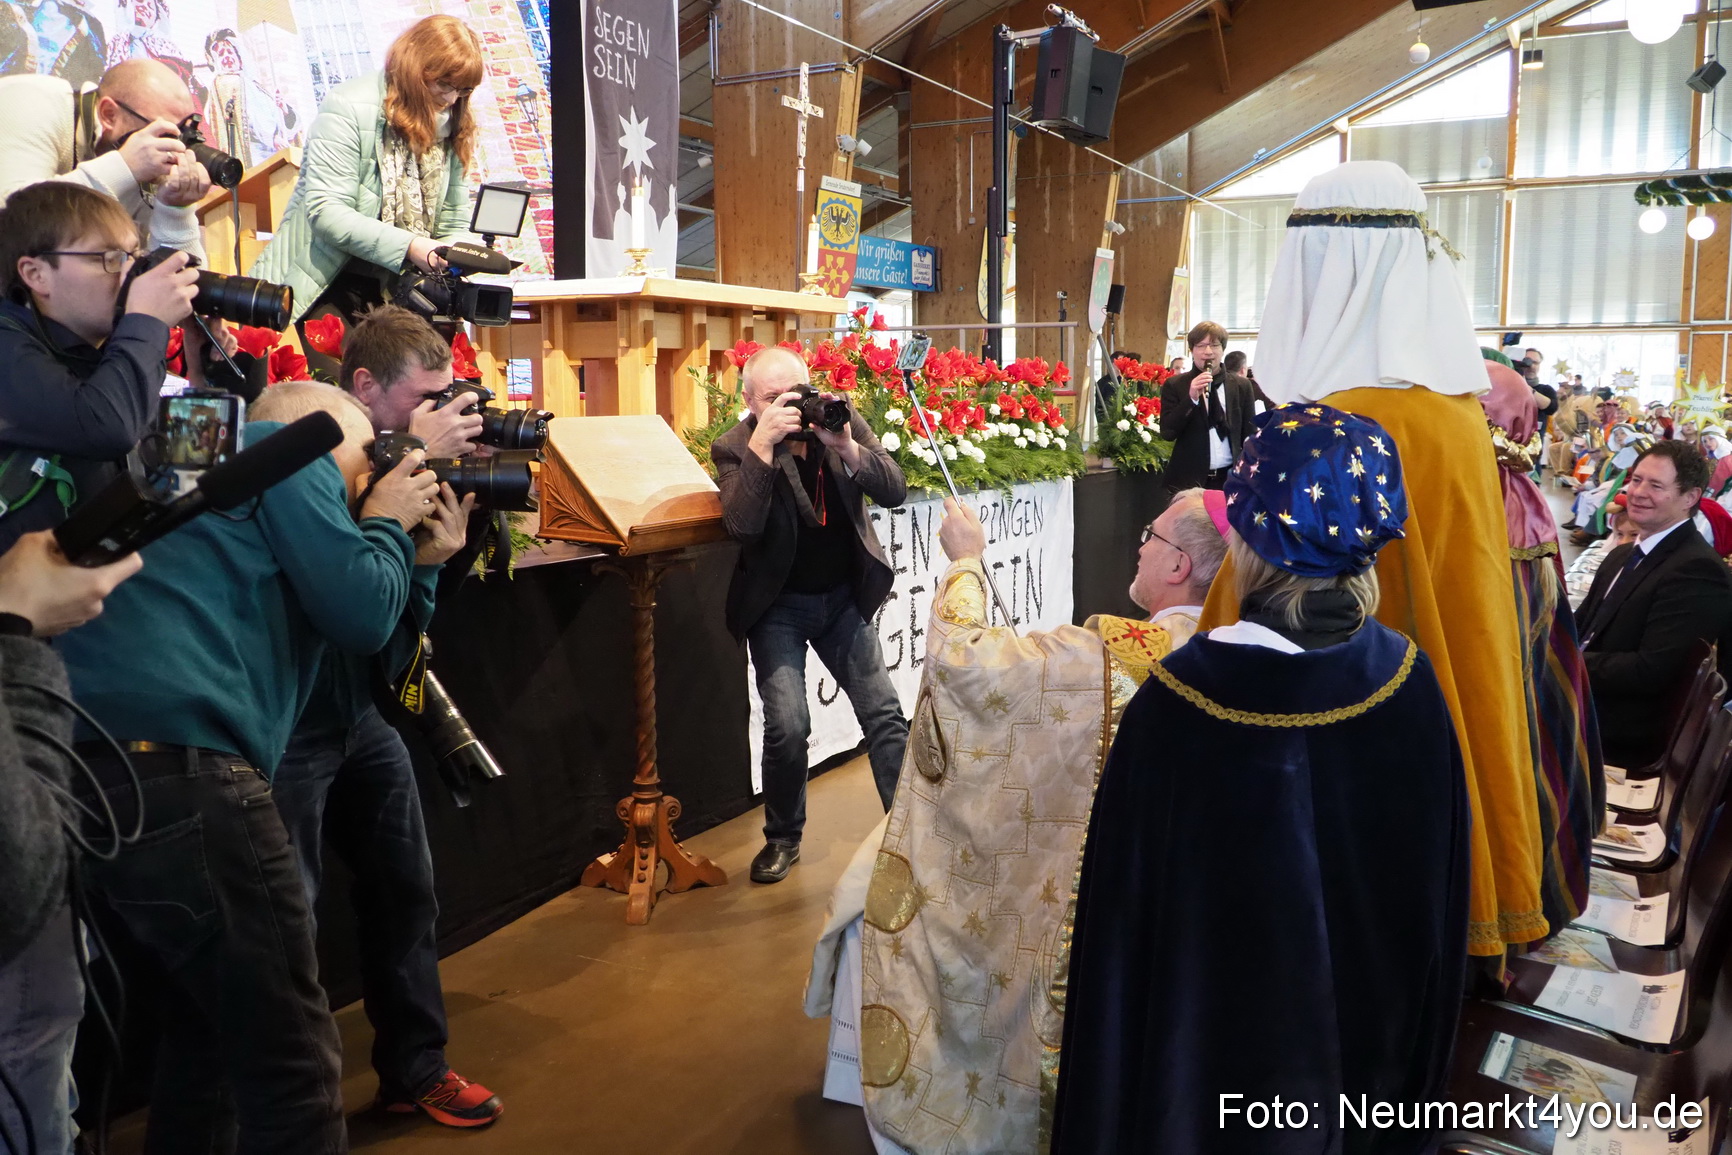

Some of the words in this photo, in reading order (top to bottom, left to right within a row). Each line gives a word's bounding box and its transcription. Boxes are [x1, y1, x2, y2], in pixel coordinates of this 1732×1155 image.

[594, 6, 650, 59] SEGEN
[593, 44, 637, 90] SEIN
[874, 240, 905, 267] grüßen
[882, 265, 908, 284] Gäste!
